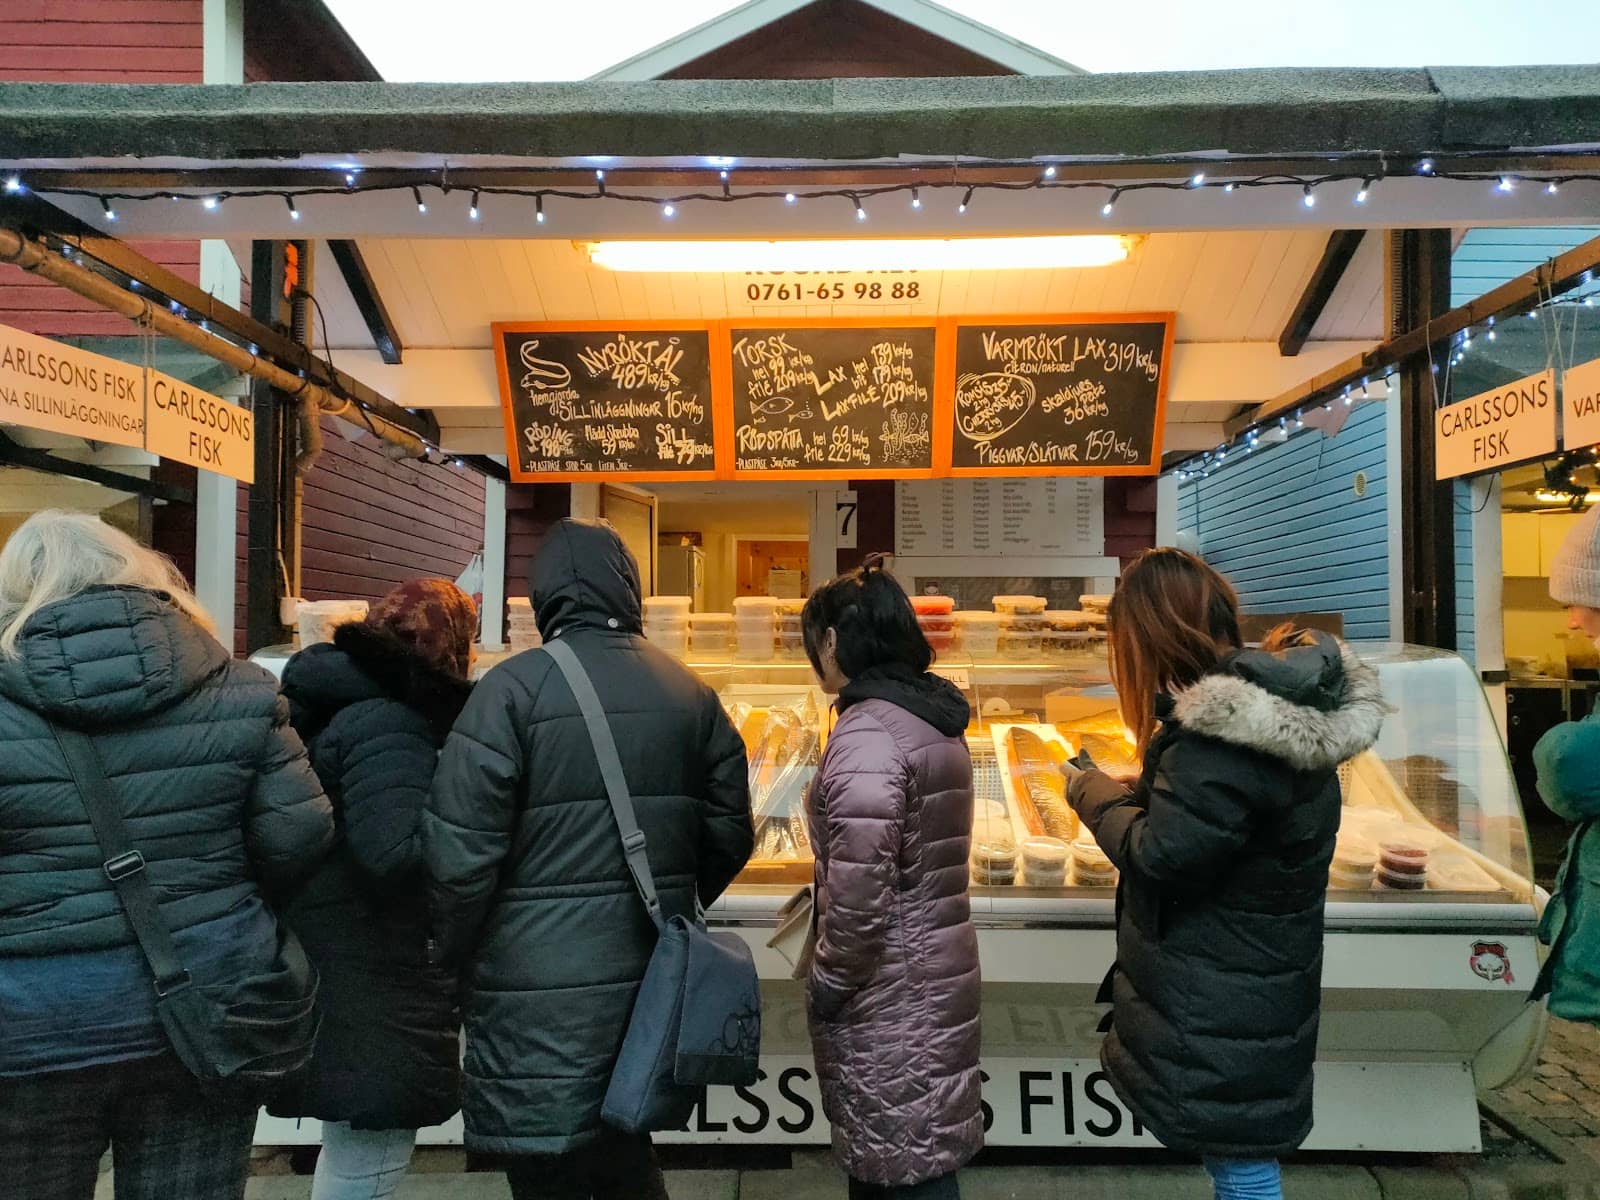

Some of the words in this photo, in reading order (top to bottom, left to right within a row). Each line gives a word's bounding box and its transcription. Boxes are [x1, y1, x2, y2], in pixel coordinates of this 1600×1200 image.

[747, 282, 844, 300] 0761-65
[854, 282, 882, 299] 98
[891, 282, 919, 299] 88
[577, 333, 659, 374] NYRÖKT
[733, 333, 797, 367] TORSK
[852, 357, 869, 374] hel
[871, 342, 893, 366] 139
[982, 331, 1067, 361] VARMRÖKT
[1074, 337, 1107, 360] LAX
[1104, 342, 1135, 372] 319
[611, 364, 648, 389] 489
[752, 365, 770, 381] hel
[769, 356, 785, 376] 99
[774, 370, 796, 392] 209
[811, 366, 848, 395] LAX
[872, 365, 891, 384] 179
[104, 373, 136, 402] FISK
[881, 381, 904, 408] 209
[24, 392, 145, 435] SILLINLÄGGNINGAR
[154, 380, 250, 441] CARLSSONS
[1441, 380, 1548, 438] CARLSSONS
[189, 432, 222, 465] FISK
[524, 421, 576, 447] RÖDING
[602, 439, 616, 455] 59
[655, 423, 690, 445] SILL
[813, 431, 826, 446] hel
[832, 425, 849, 445] 69
[1085, 430, 1115, 461] 159
[1474, 430, 1509, 463] FISK
[828, 444, 851, 462] 229
[836, 503, 857, 535] 7
[1019, 1071, 1143, 1137] FIS
